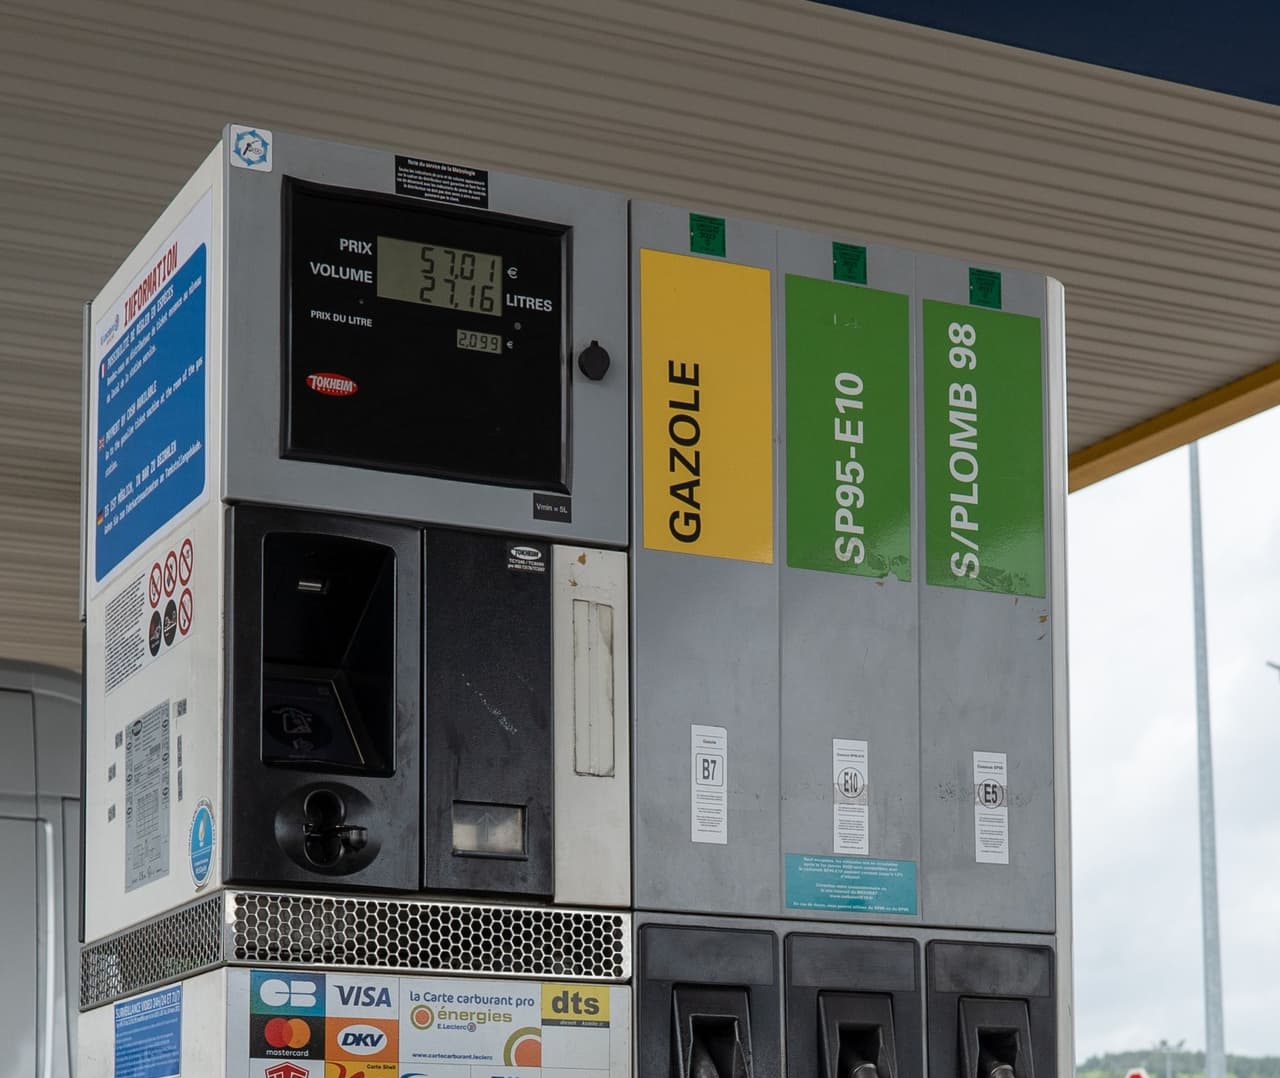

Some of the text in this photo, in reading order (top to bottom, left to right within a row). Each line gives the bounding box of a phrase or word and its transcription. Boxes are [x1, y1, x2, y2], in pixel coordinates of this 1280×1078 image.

[339, 238, 373, 255] PRIX
[310, 261, 373, 284] VOLUME
[421, 247, 519, 283] 57,01 €
[124, 241, 178, 327] INFORMATION
[420, 276, 553, 313] 27,16 LITRES
[310, 310, 373, 327] PRIX DU LITRE
[308, 375, 353, 392] TOKHEIM
[668, 360, 701, 543] GAZOLE
[947, 322, 981, 580] S/PLOMB 98
[835, 372, 867, 565] SP95-E10
[702, 758, 717, 780] B7
[844, 772, 858, 792] E10
[984, 783, 997, 803] E5
[259, 979, 317, 1007] CB
[333, 984, 392, 1007] VISA
[409, 991, 535, 1008] la Carte carburant pro
[551, 990, 600, 1015] dts
[437, 1005, 513, 1024] énergies
[341, 1032, 384, 1047] DKV
[266, 1049, 309, 1057] mastercard
